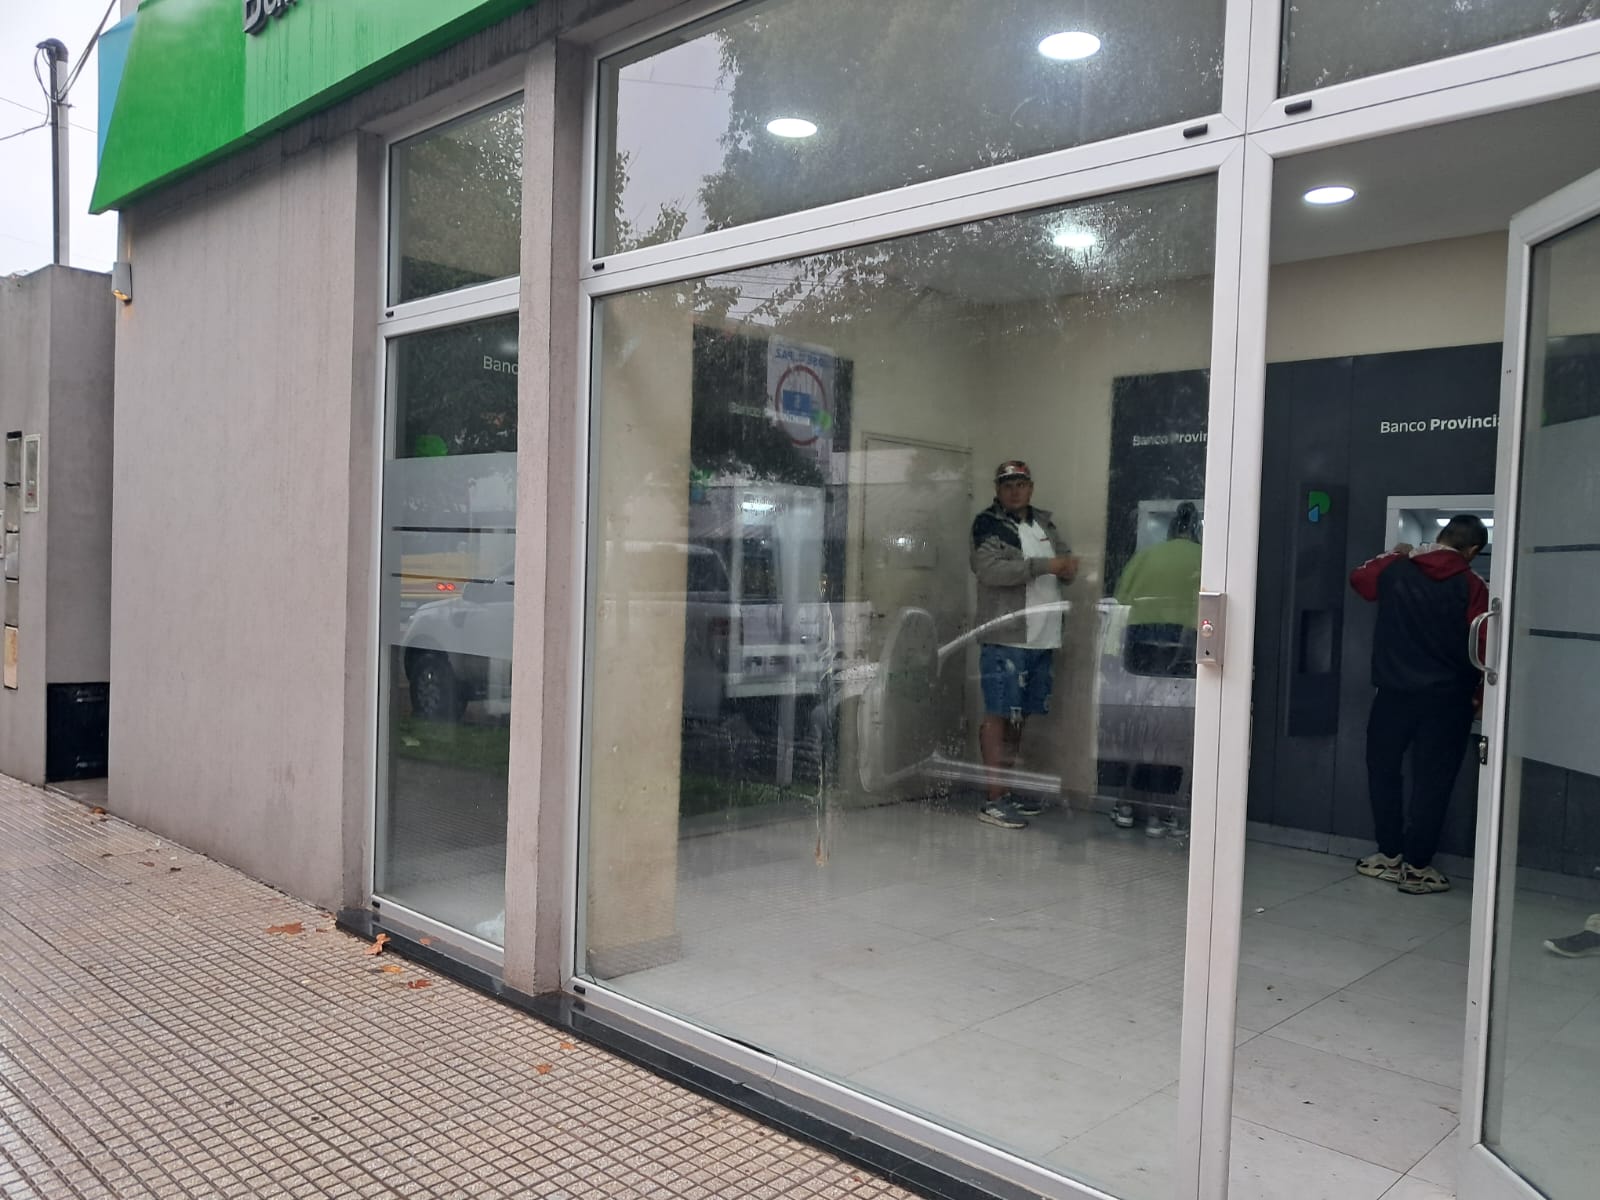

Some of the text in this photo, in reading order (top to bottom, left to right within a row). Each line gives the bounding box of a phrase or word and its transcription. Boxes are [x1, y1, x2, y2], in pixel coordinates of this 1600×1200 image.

[483, 355, 519, 375] Banc
[1380, 414, 1500, 433] Banco Provinci
